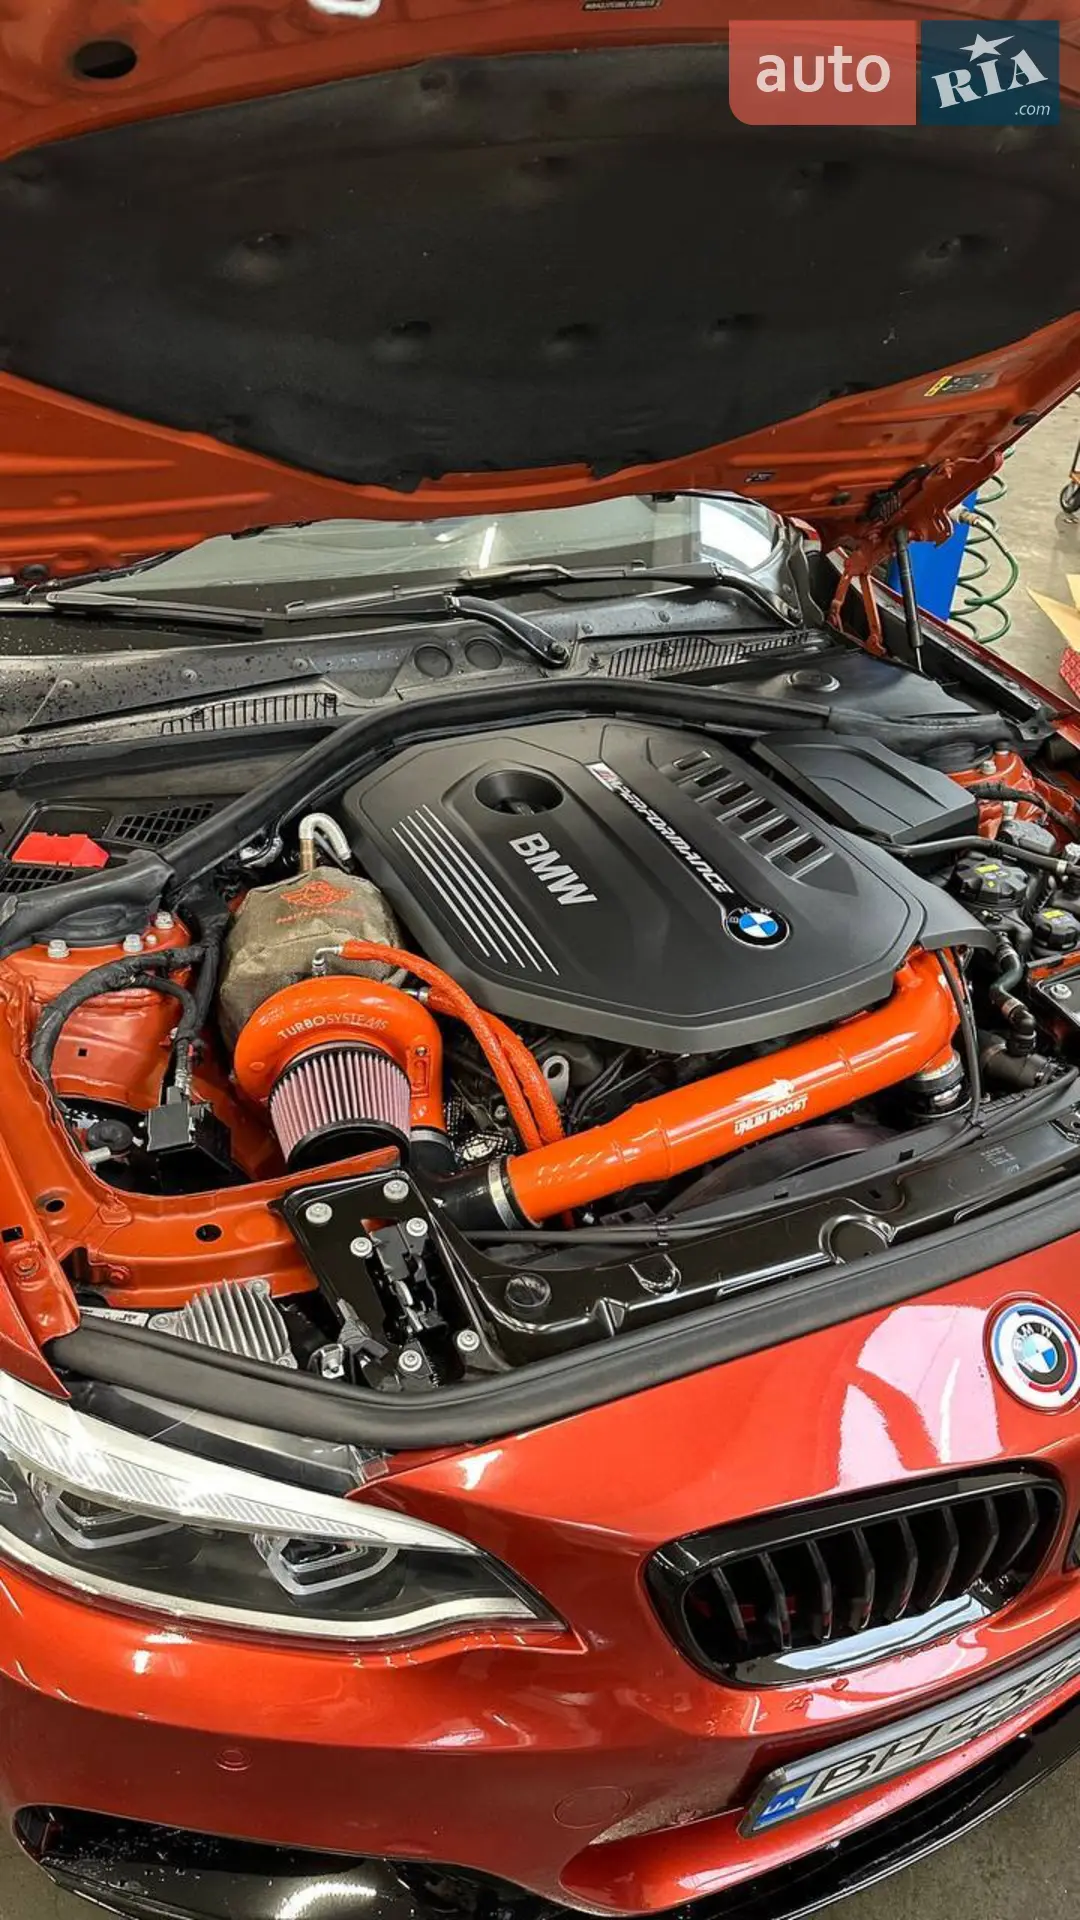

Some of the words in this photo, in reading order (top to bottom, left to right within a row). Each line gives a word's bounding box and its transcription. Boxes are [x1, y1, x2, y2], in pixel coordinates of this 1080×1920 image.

[508, 832, 598, 905] BMW
[616, 783, 735, 894] PERFORMANCE
[769, 1093, 809, 1121] BOOST
[811, 1725, 944, 1799] BH
[761, 1796, 796, 1817] UA
